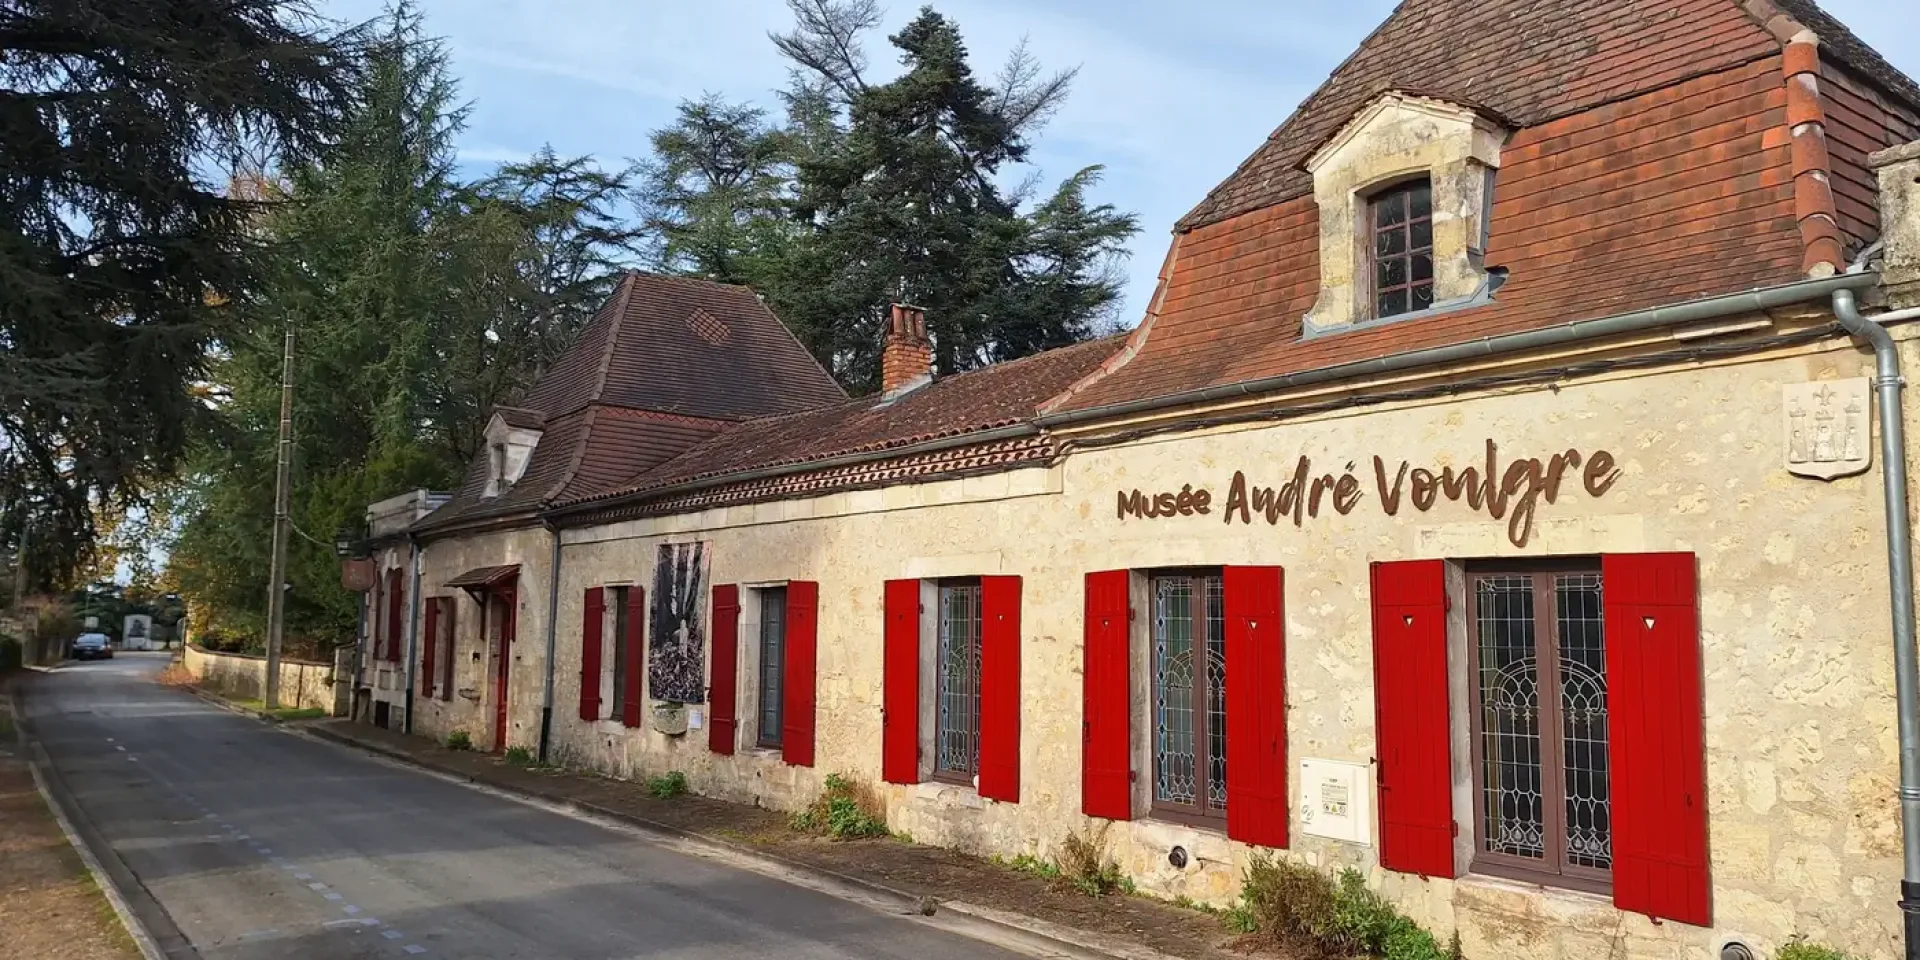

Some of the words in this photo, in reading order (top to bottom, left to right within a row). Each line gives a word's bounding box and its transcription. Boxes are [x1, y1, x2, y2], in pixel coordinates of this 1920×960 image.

[1117, 483, 1212, 520] Musée
[1224, 454, 1364, 528] André
[1373, 438, 1621, 548] Voulgre
